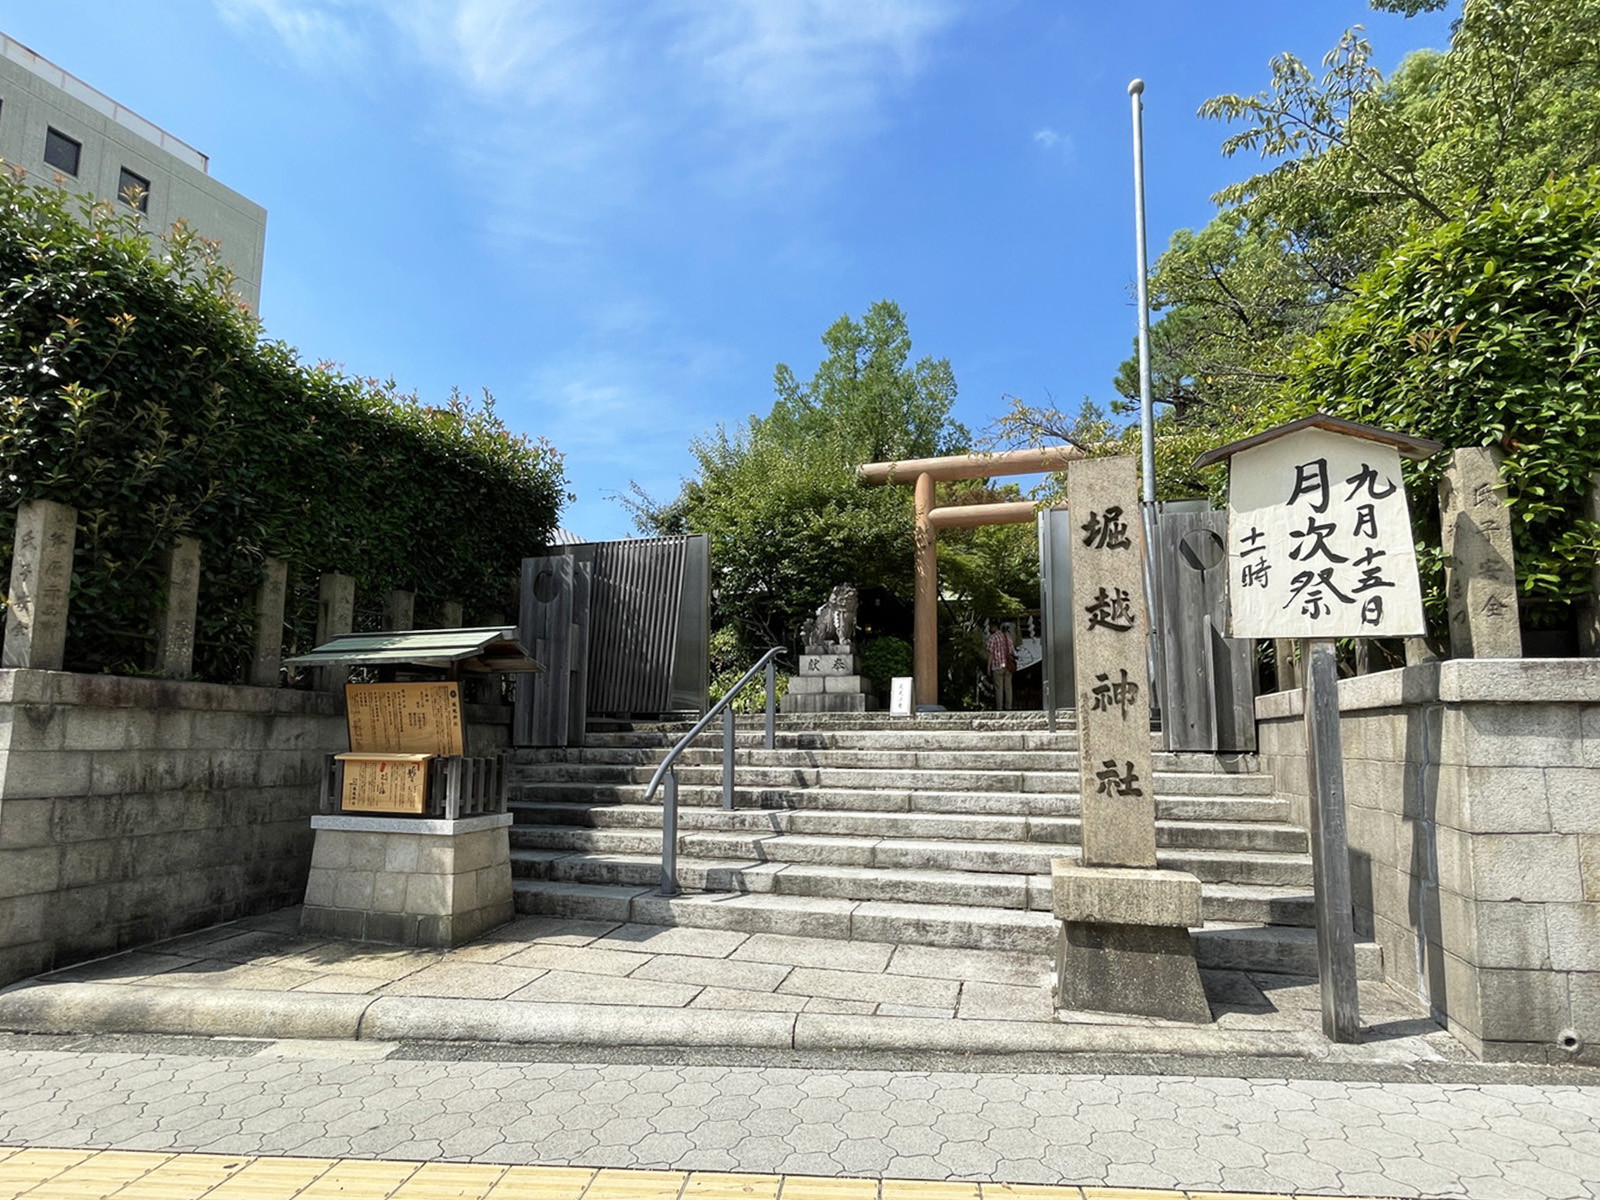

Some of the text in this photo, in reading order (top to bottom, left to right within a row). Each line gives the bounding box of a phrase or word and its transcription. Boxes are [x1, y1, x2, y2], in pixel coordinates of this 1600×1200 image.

[1239, 527, 1272, 589] 十一時
[1283, 458, 1356, 619] 月次祭
[1344, 463, 1397, 626] 九月十五日
[1473, 482, 1508, 617] 氏子安全
[1081, 505, 1143, 798] 堀越神社
